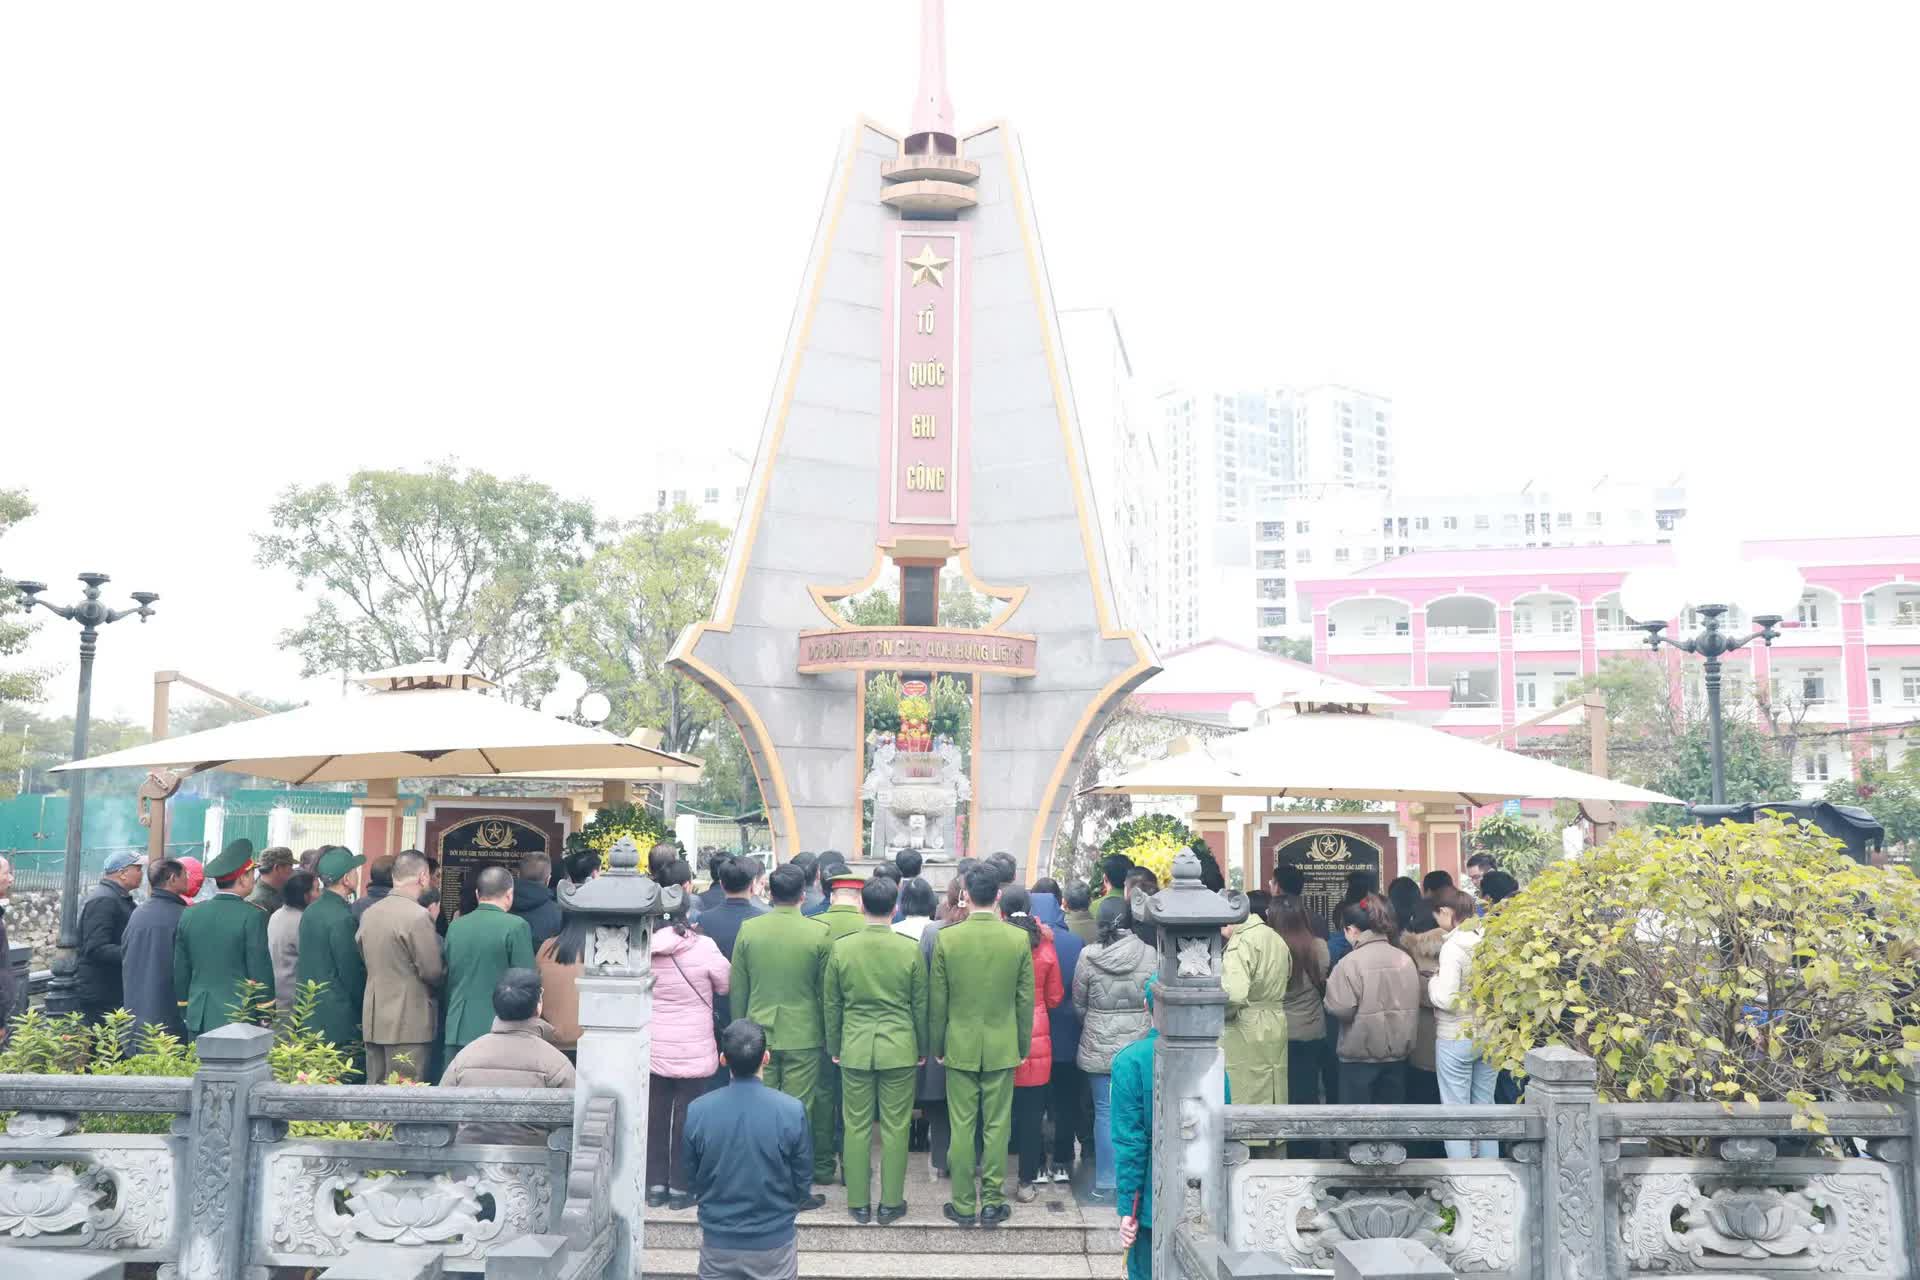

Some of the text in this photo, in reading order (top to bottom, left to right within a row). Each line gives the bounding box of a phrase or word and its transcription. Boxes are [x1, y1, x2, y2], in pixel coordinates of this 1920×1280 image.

[909, 356, 945, 388] QUỐC
[911, 415, 936, 439] GHI
[906, 461, 945, 491] CÔNG
